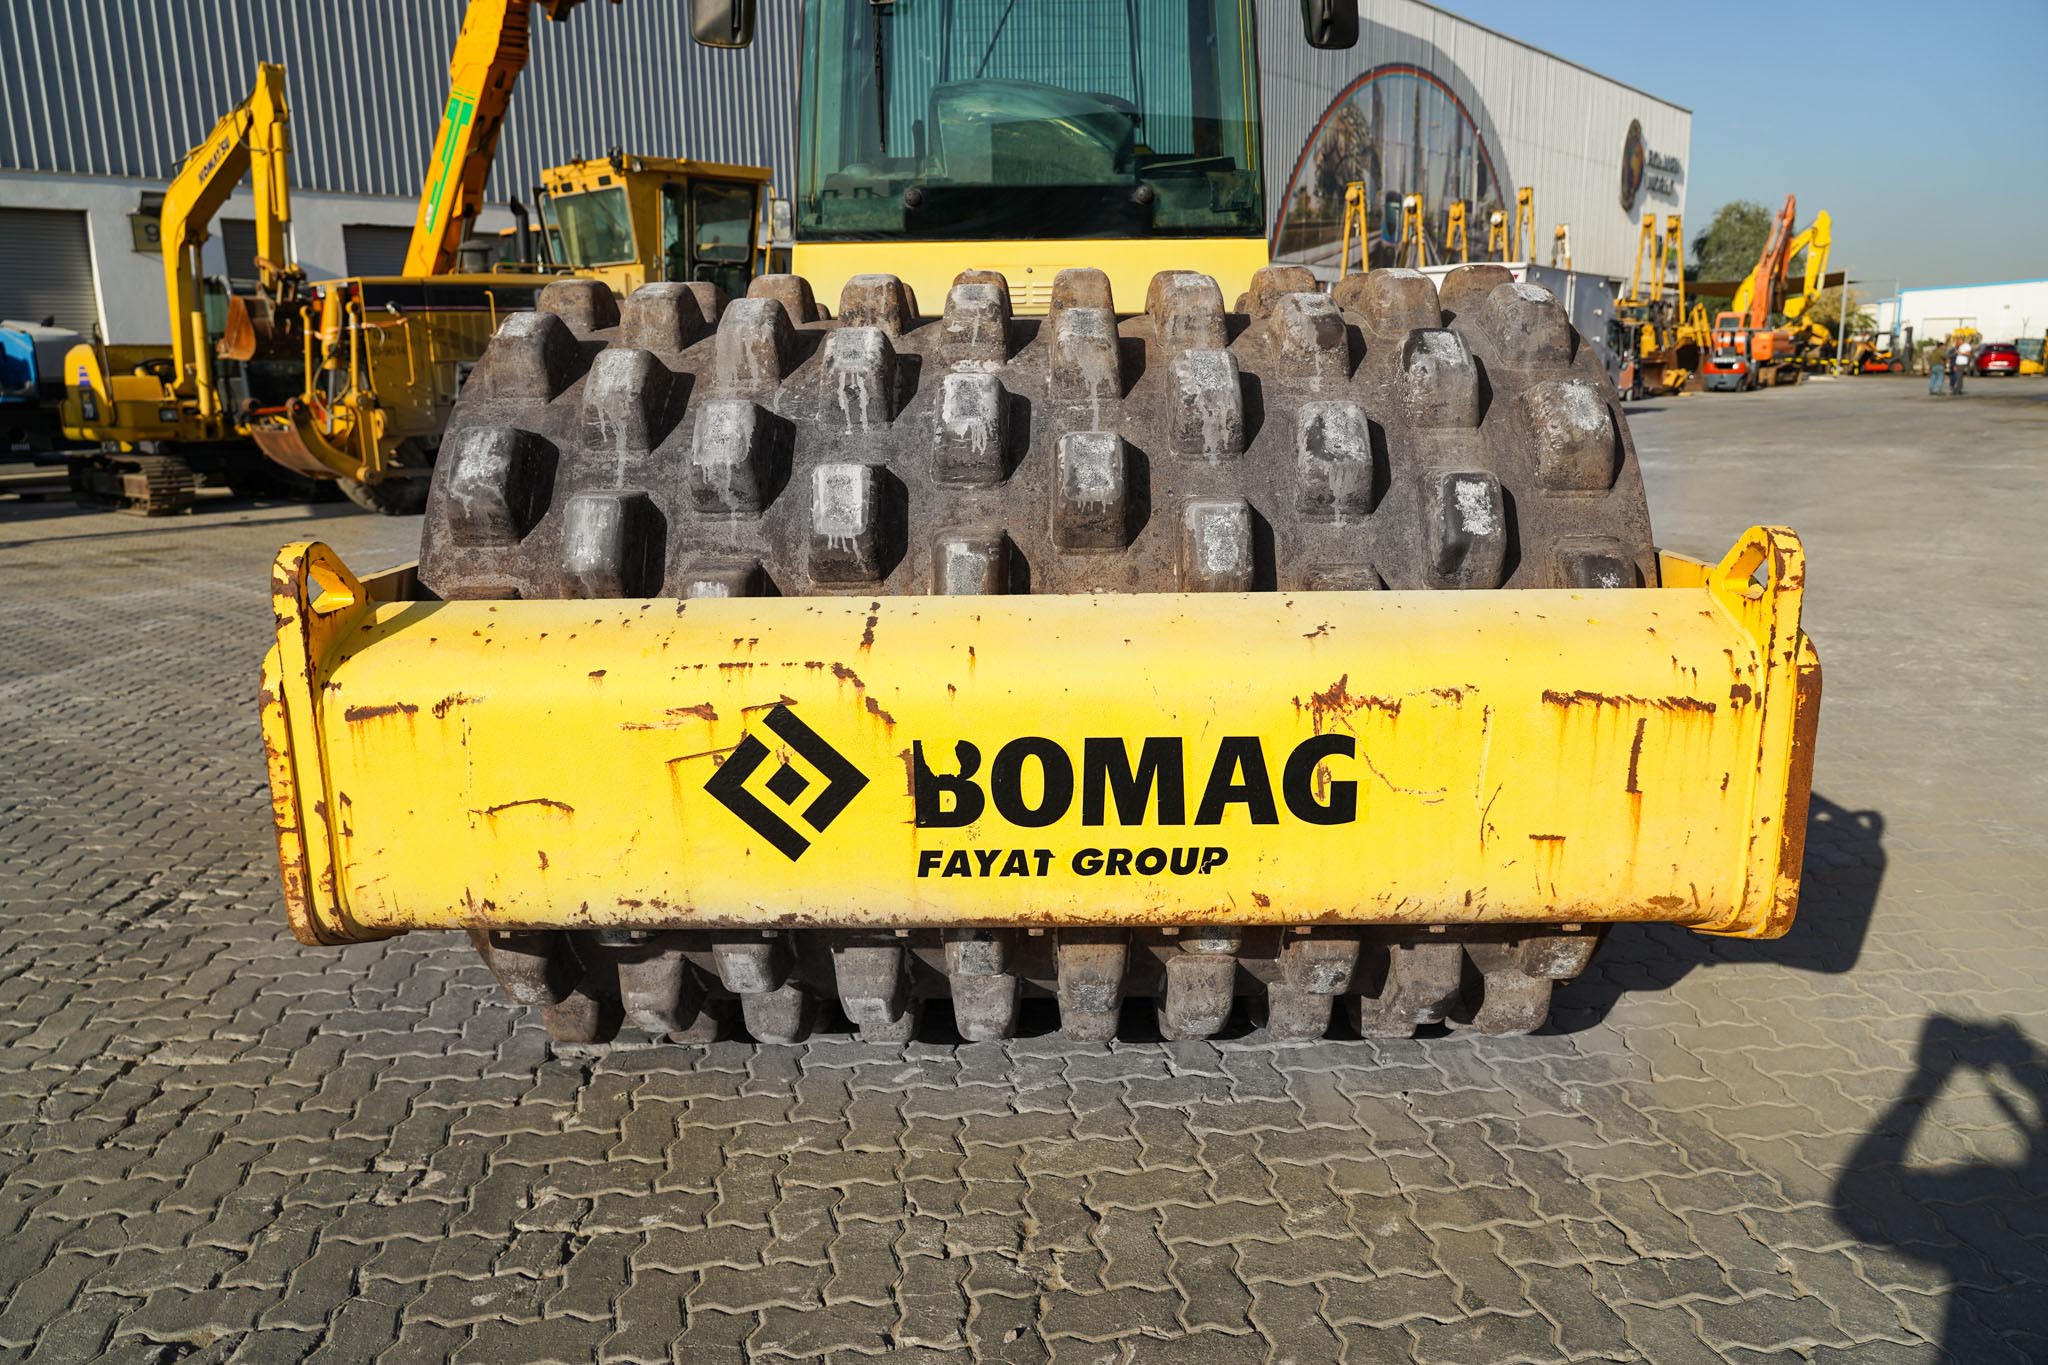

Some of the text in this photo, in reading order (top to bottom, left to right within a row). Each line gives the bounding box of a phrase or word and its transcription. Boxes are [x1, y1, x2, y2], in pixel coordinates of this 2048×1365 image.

[198, 136, 230, 185] KOMATSU
[145, 223, 160, 243] 9
[913, 734, 1358, 828] BOMAG
[917, 846, 1229, 878] FAYAT GROUP
